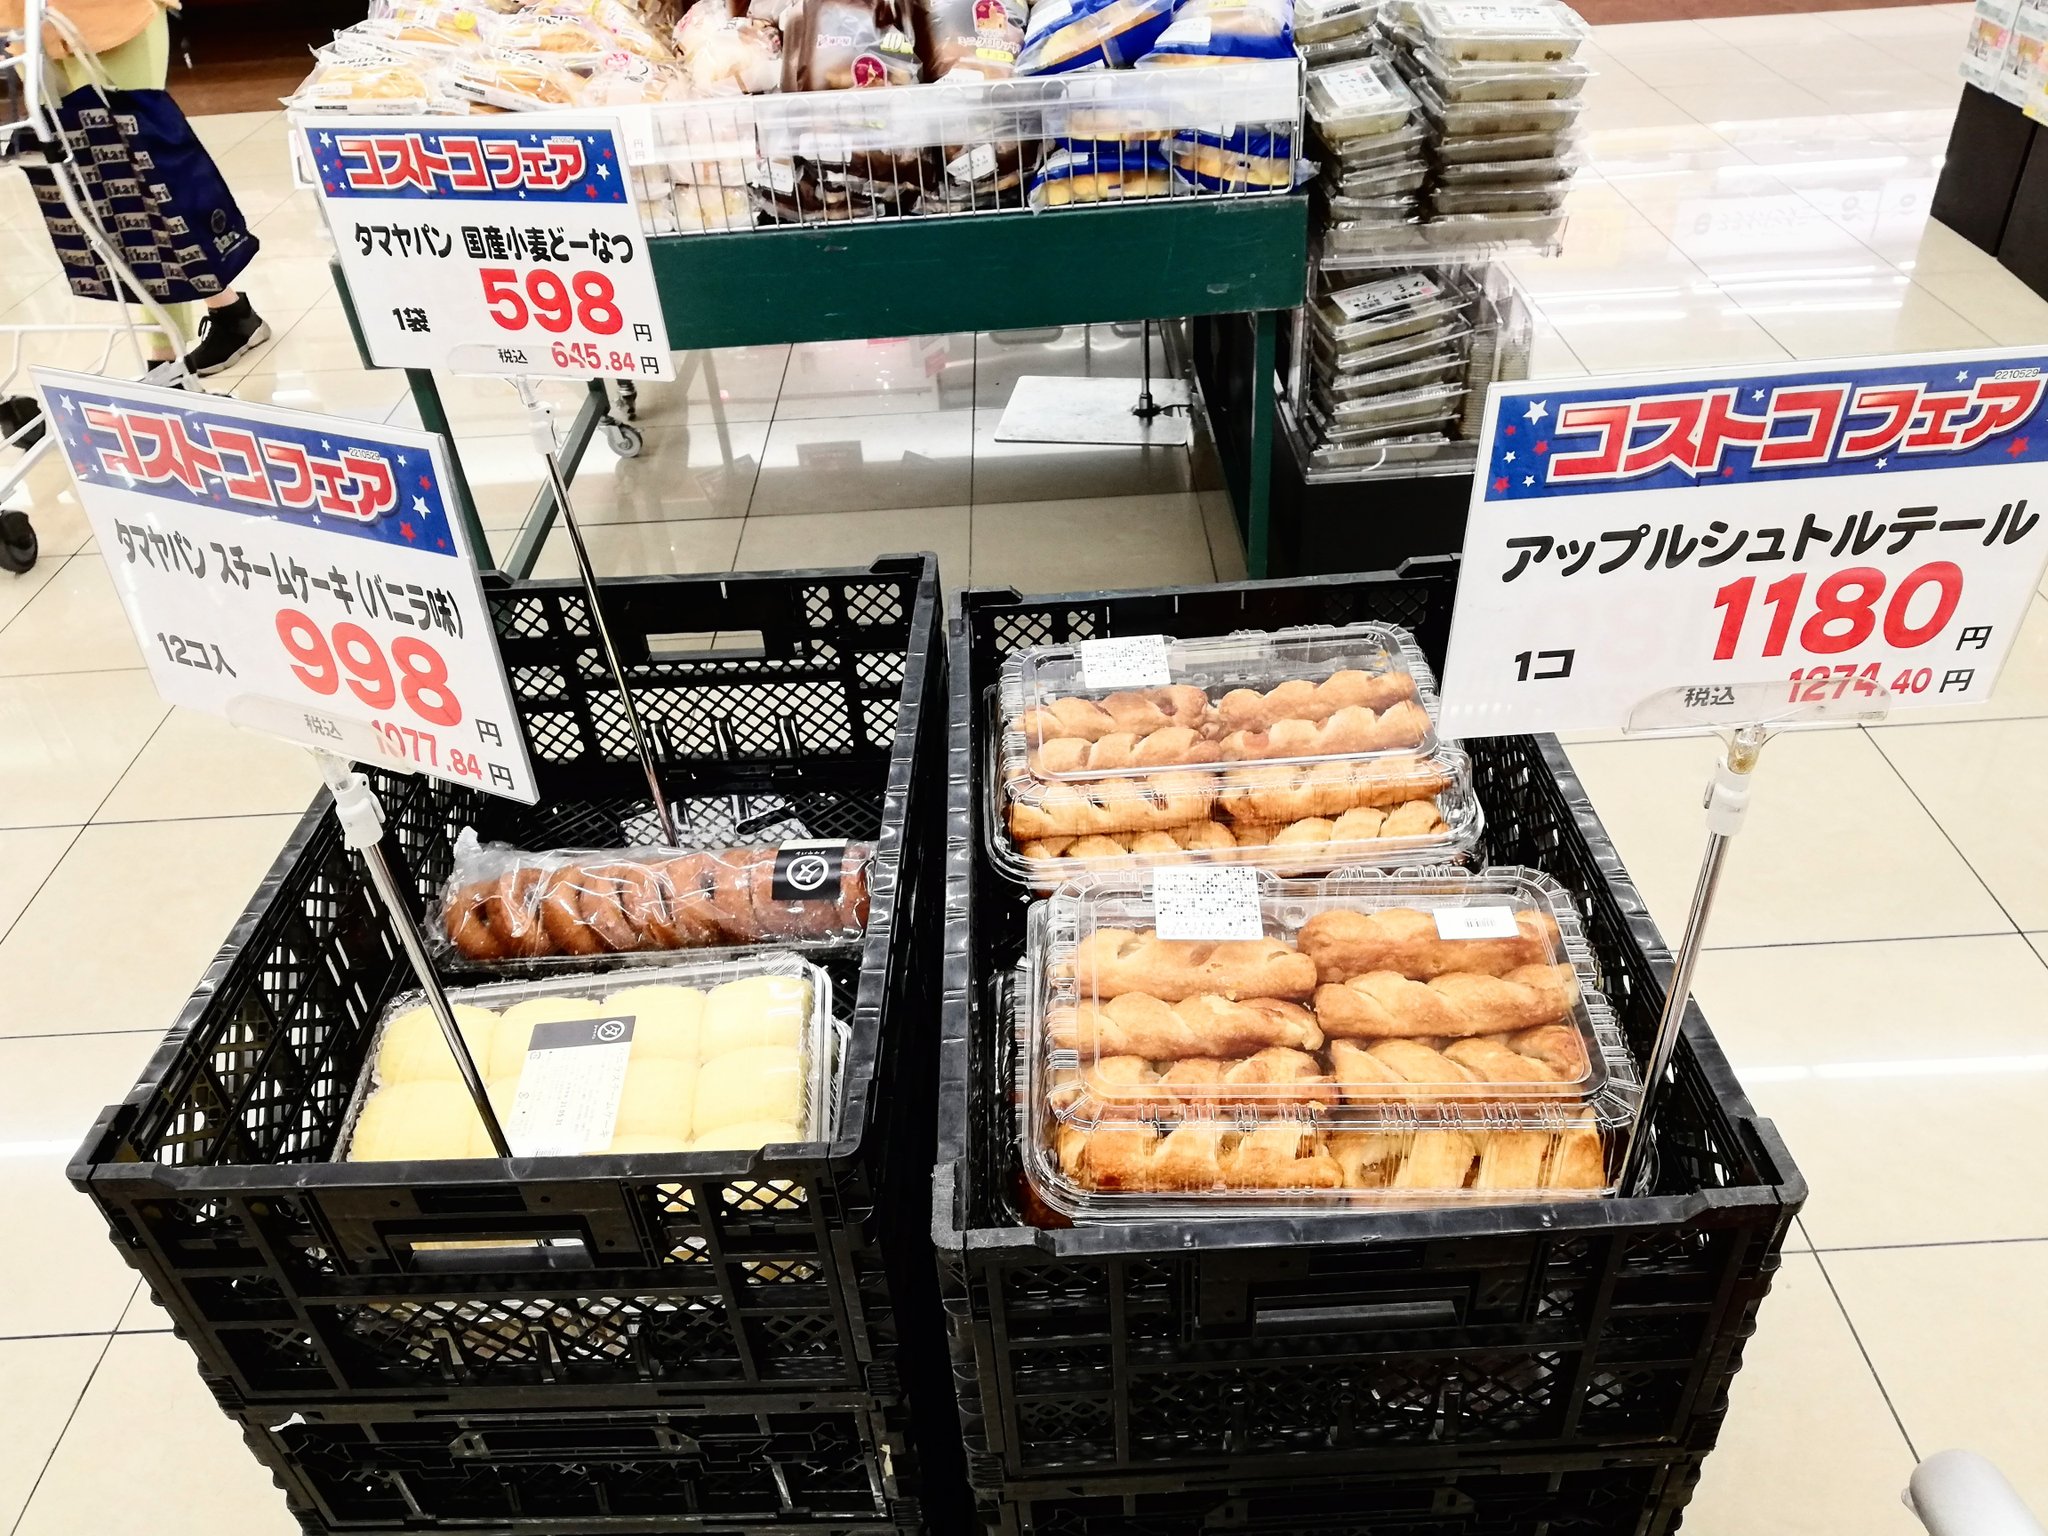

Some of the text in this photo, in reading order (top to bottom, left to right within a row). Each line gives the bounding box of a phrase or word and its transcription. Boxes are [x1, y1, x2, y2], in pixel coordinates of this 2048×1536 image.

[355, 222, 633, 263] タマヤパン 国産小麦どーなつ
[392, 307, 430, 333] 1袋
[479, 268, 652, 342] 598 円
[498, 341, 660, 375] 税込 645.84 円
[1995, 368, 2039, 380] 2210529
[1502, 499, 2040, 583] アップルシュトルテール
[114, 518, 465, 640] タマヤパン スチームケーキ(バニラ味)
[1713, 560, 1993, 661] 1180 円
[157, 632, 236, 678] 12コ入
[276, 608, 502, 747] 998 円
[1514, 649, 1576, 682] 1コ
[1684, 662, 1975, 708] 税込 1274.40 円
[304, 713, 515, 791] 税込 1077.84 円
